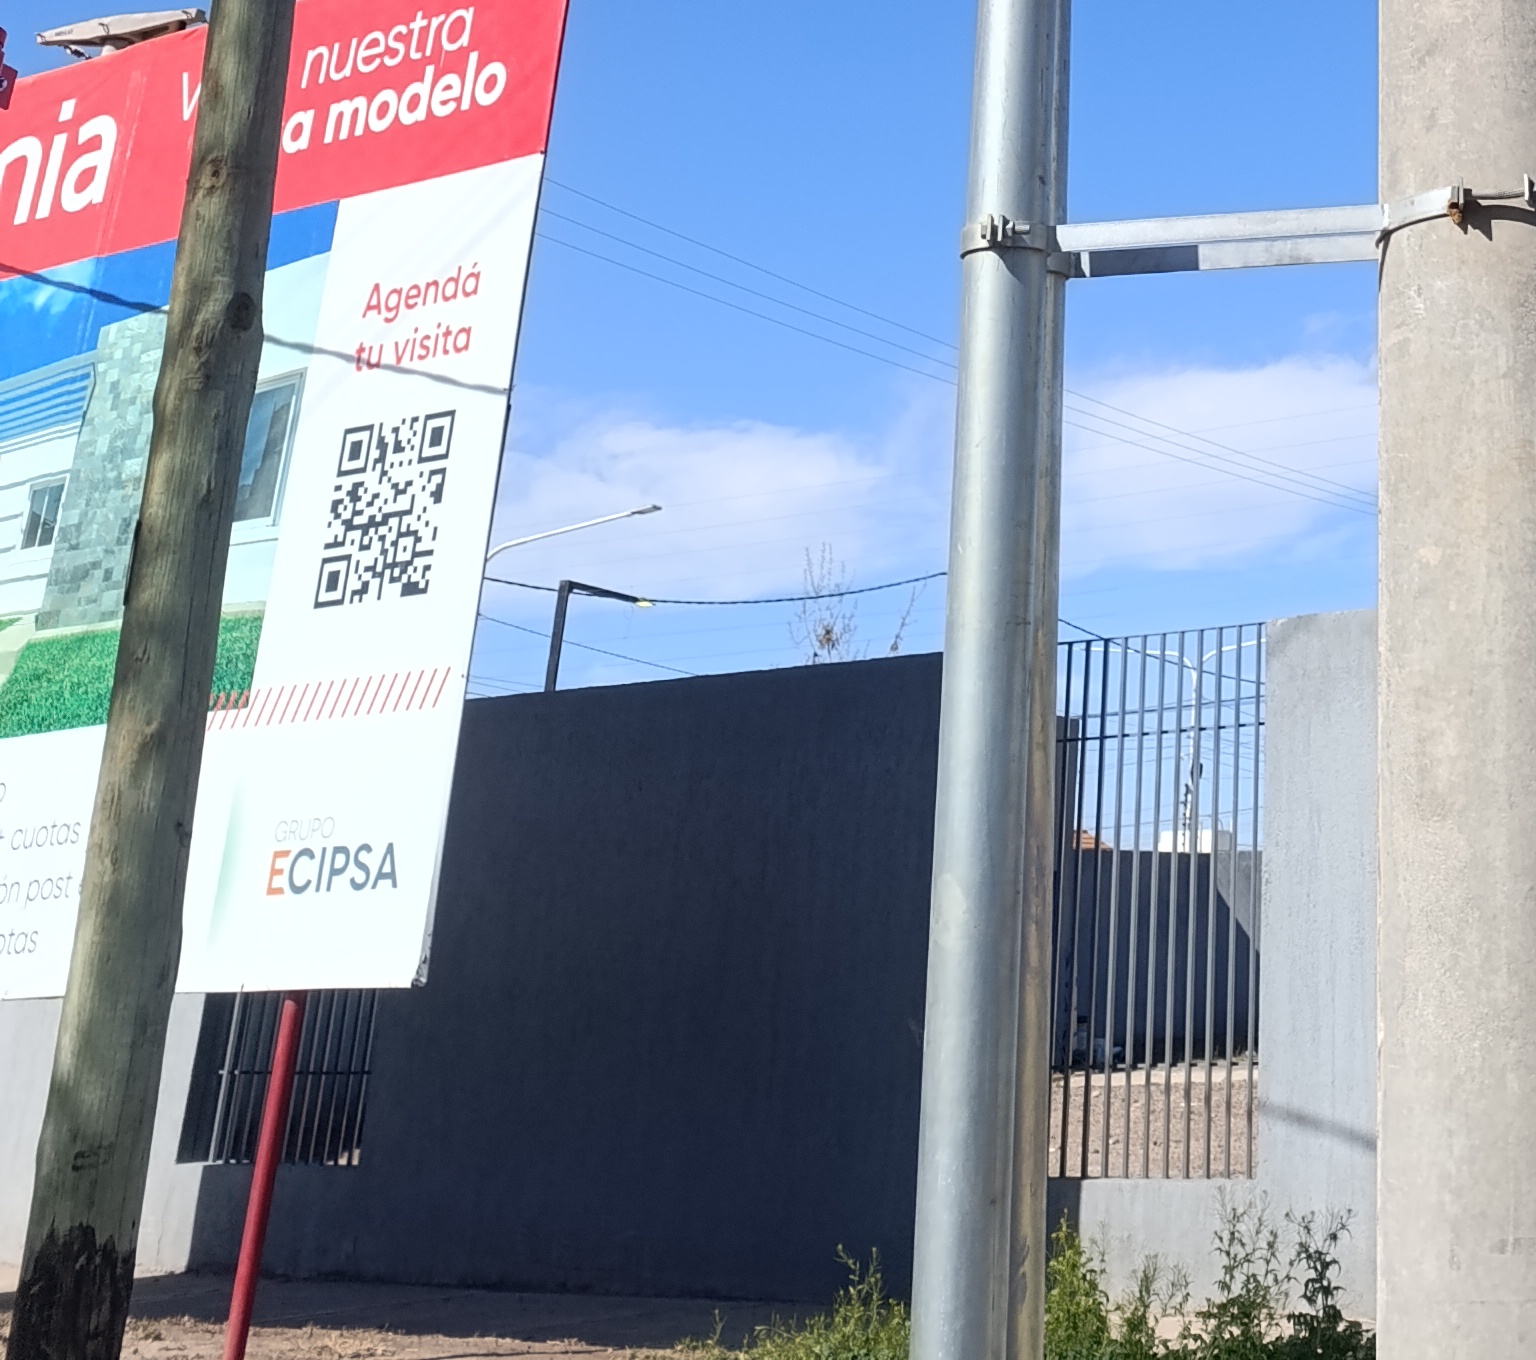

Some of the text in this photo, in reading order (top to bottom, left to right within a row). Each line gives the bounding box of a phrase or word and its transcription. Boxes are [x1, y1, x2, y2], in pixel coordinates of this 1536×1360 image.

[301, 7, 475, 88] nuestra
[324, 51, 507, 144] modelo
[362, 262, 481, 323] Agendá
[355, 322, 472, 372] tu visita
[10, 819, 81, 851] cuotas
[274, 816, 335, 843] GRUPO
[24, 871, 73, 910] post
[266, 842, 398, 896] ECIPSA
